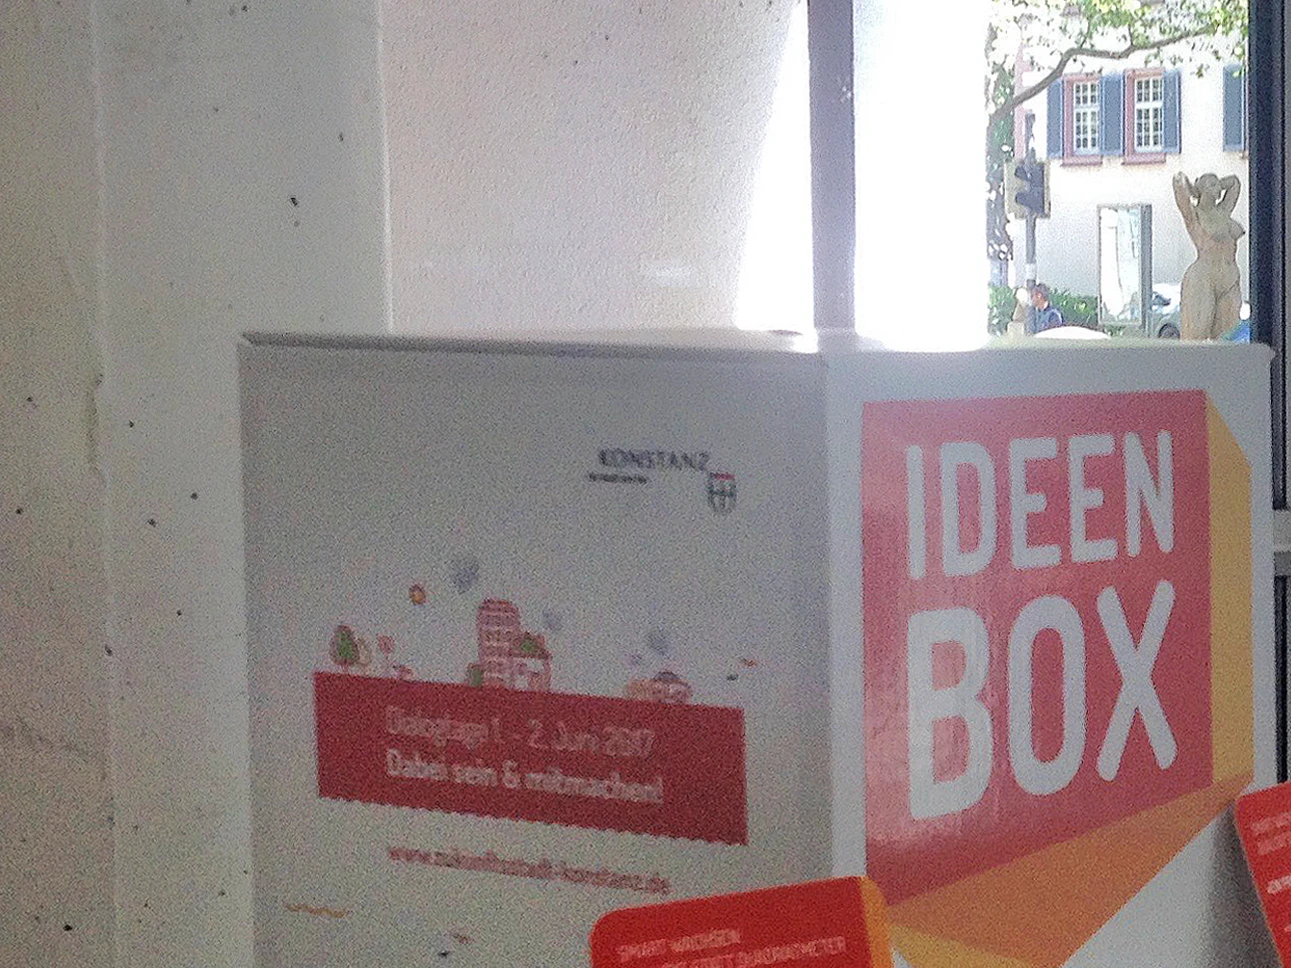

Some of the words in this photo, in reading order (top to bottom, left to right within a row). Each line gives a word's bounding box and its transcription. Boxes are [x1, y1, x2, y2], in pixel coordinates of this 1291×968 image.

[598, 447, 711, 473] KONSTANZ
[905, 429, 1175, 580] IDEEN
[907, 579, 1178, 821] BOX
[386, 748, 448, 782] Dabei
[451, 757, 498, 786] sein
